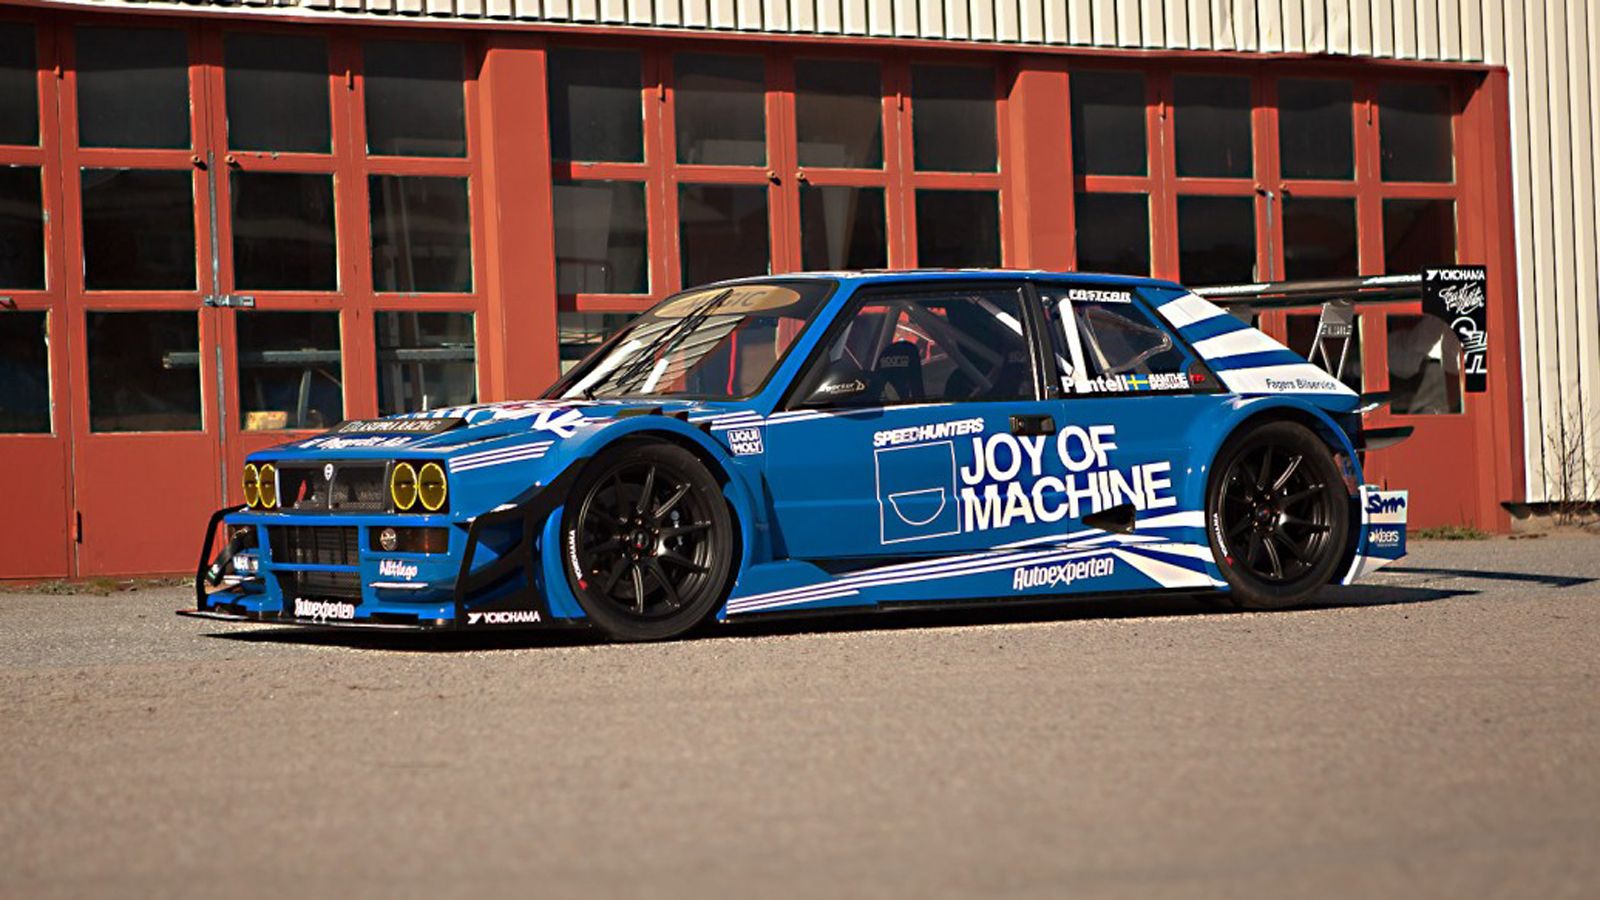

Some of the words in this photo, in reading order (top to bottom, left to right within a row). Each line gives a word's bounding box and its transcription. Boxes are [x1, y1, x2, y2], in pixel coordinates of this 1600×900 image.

[1439, 269, 1485, 281] YOKOHAMA
[730, 429, 759, 443] LIQUI
[873, 417, 984, 447] SPEEDHUNTERS
[733, 440, 762, 454] MOLY
[961, 432, 1048, 486] JOY
[1057, 425, 1119, 473] OF
[961, 461, 1177, 532] MACHINE
[1013, 556, 1115, 591] Autoexperten
[483, 610, 541, 624] YOKOHAMA
